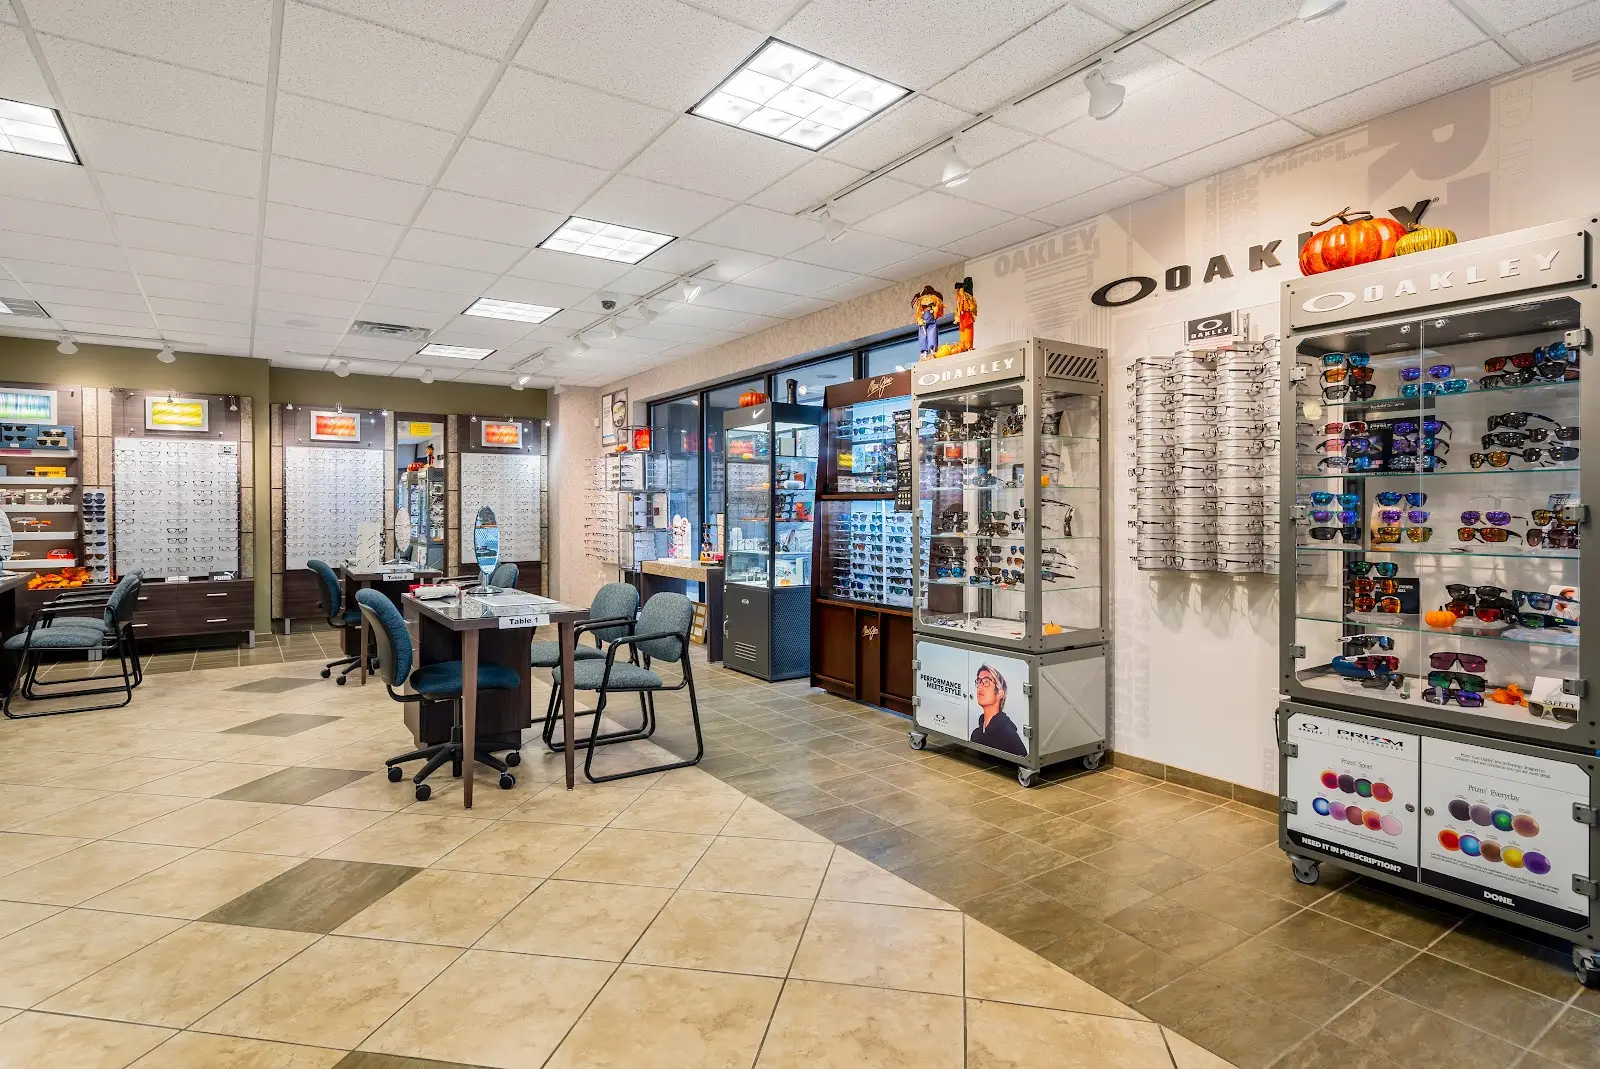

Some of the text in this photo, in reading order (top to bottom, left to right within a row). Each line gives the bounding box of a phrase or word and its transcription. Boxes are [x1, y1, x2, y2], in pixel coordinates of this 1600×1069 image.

[994, 225, 1097, 278] OAKLEY
[1165, 199, 1431, 291] OAKY
[1363, 250, 1560, 302] OAKLEY
[1190, 326, 1229, 339] OAKLEY
[941, 357, 1014, 382] OAKLEY
[509, 617, 532, 625] Table
[920, 674, 961, 690] PERFORMANCE
[926, 682, 962, 697] MEETS STYLE
[1543, 700, 1576, 708] SAFETY
[1338, 729, 1403, 748] PRIZM
[1490, 790, 1520, 803] Everyday
[1302, 836, 1402, 872] NEED IT IN PRESCRIPTION?
[1484, 890, 1515, 907] DONE.
